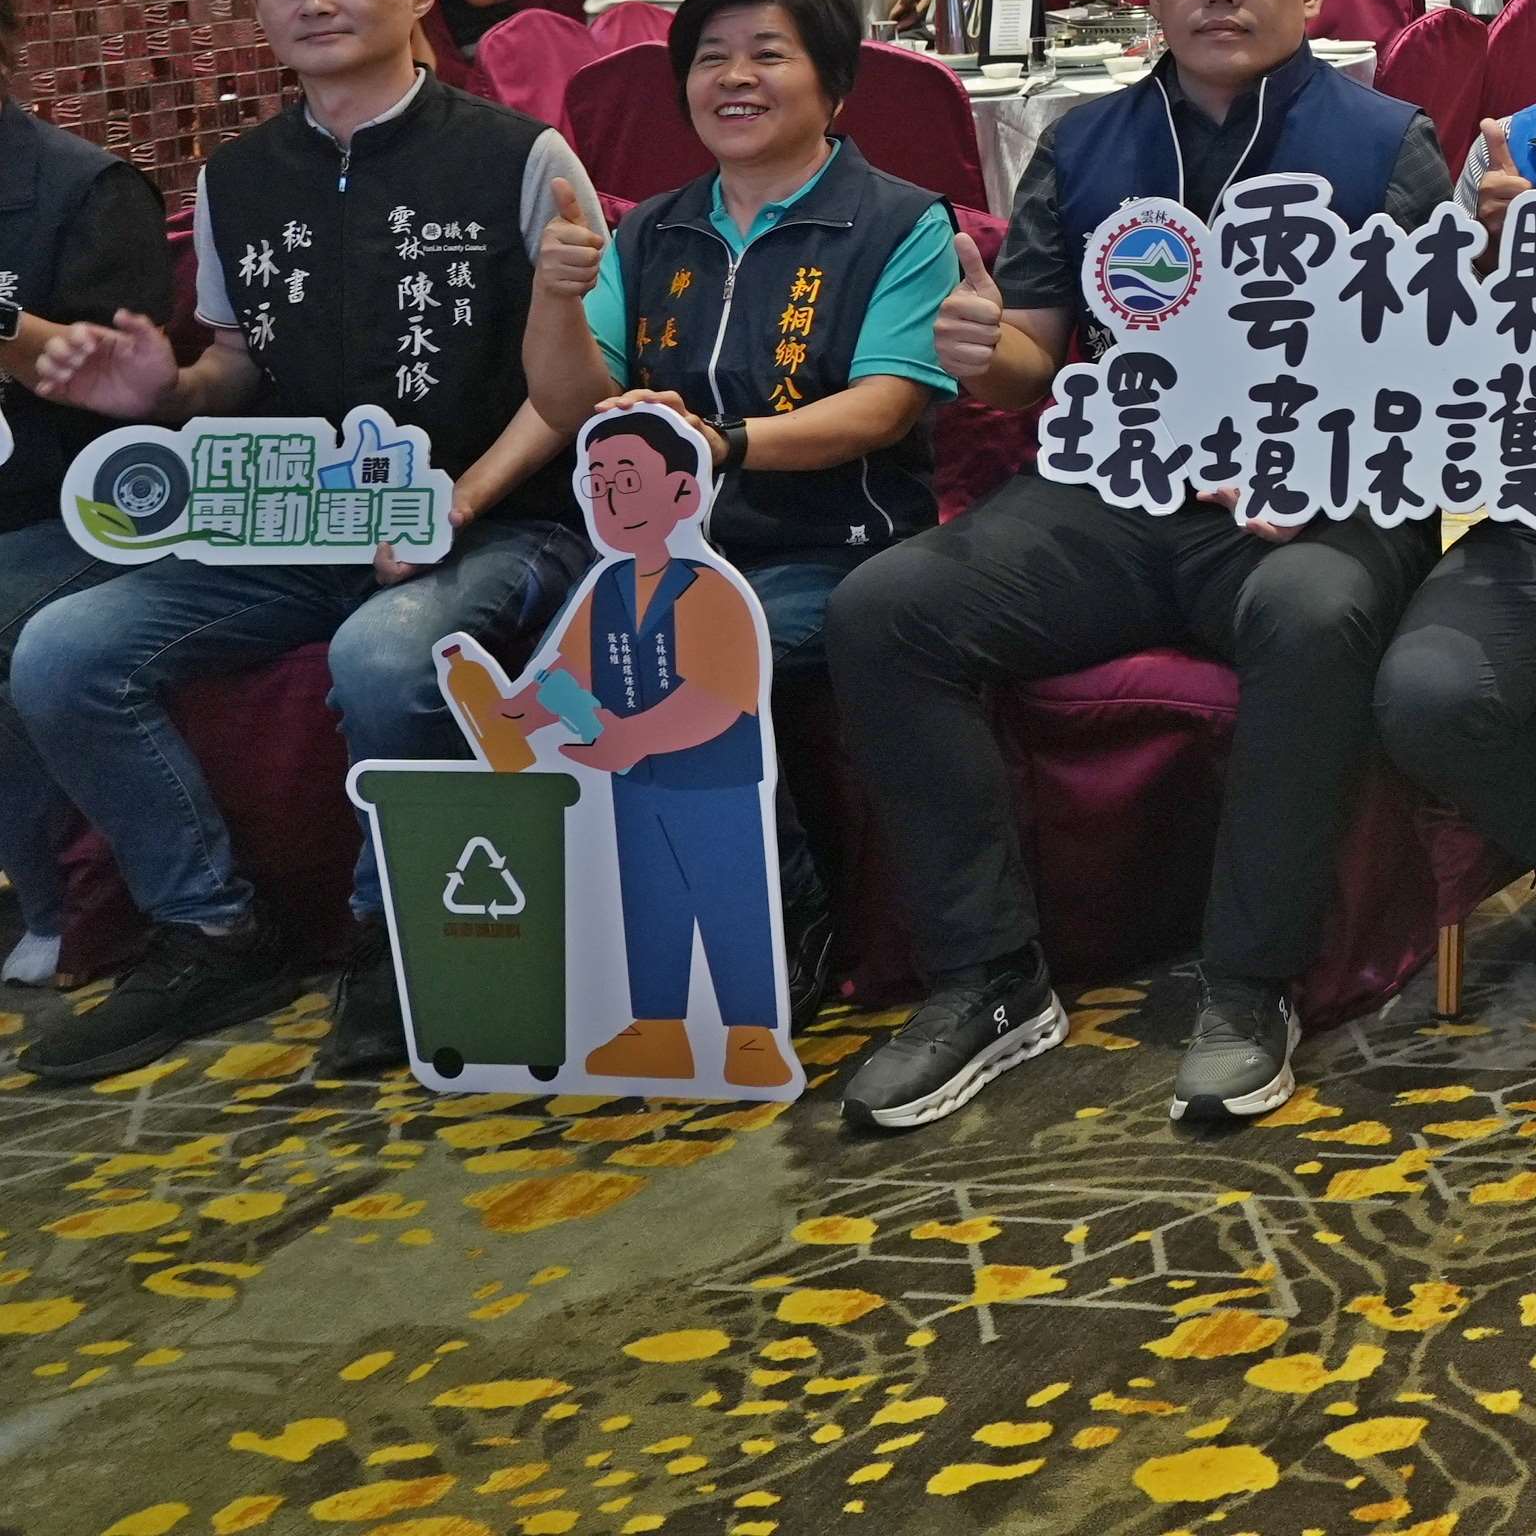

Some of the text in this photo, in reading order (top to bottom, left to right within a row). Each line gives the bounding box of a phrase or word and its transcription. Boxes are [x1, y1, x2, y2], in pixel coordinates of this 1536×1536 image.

[1141, 210, 1168, 224] 雲林
[282, 220, 313, 304] 秘書
[446, 261, 477, 327] 議員
[394, 271, 443, 403] 陳永修
[192, 433, 316, 490] 低碳
[188, 488, 435, 547] 電動運具
